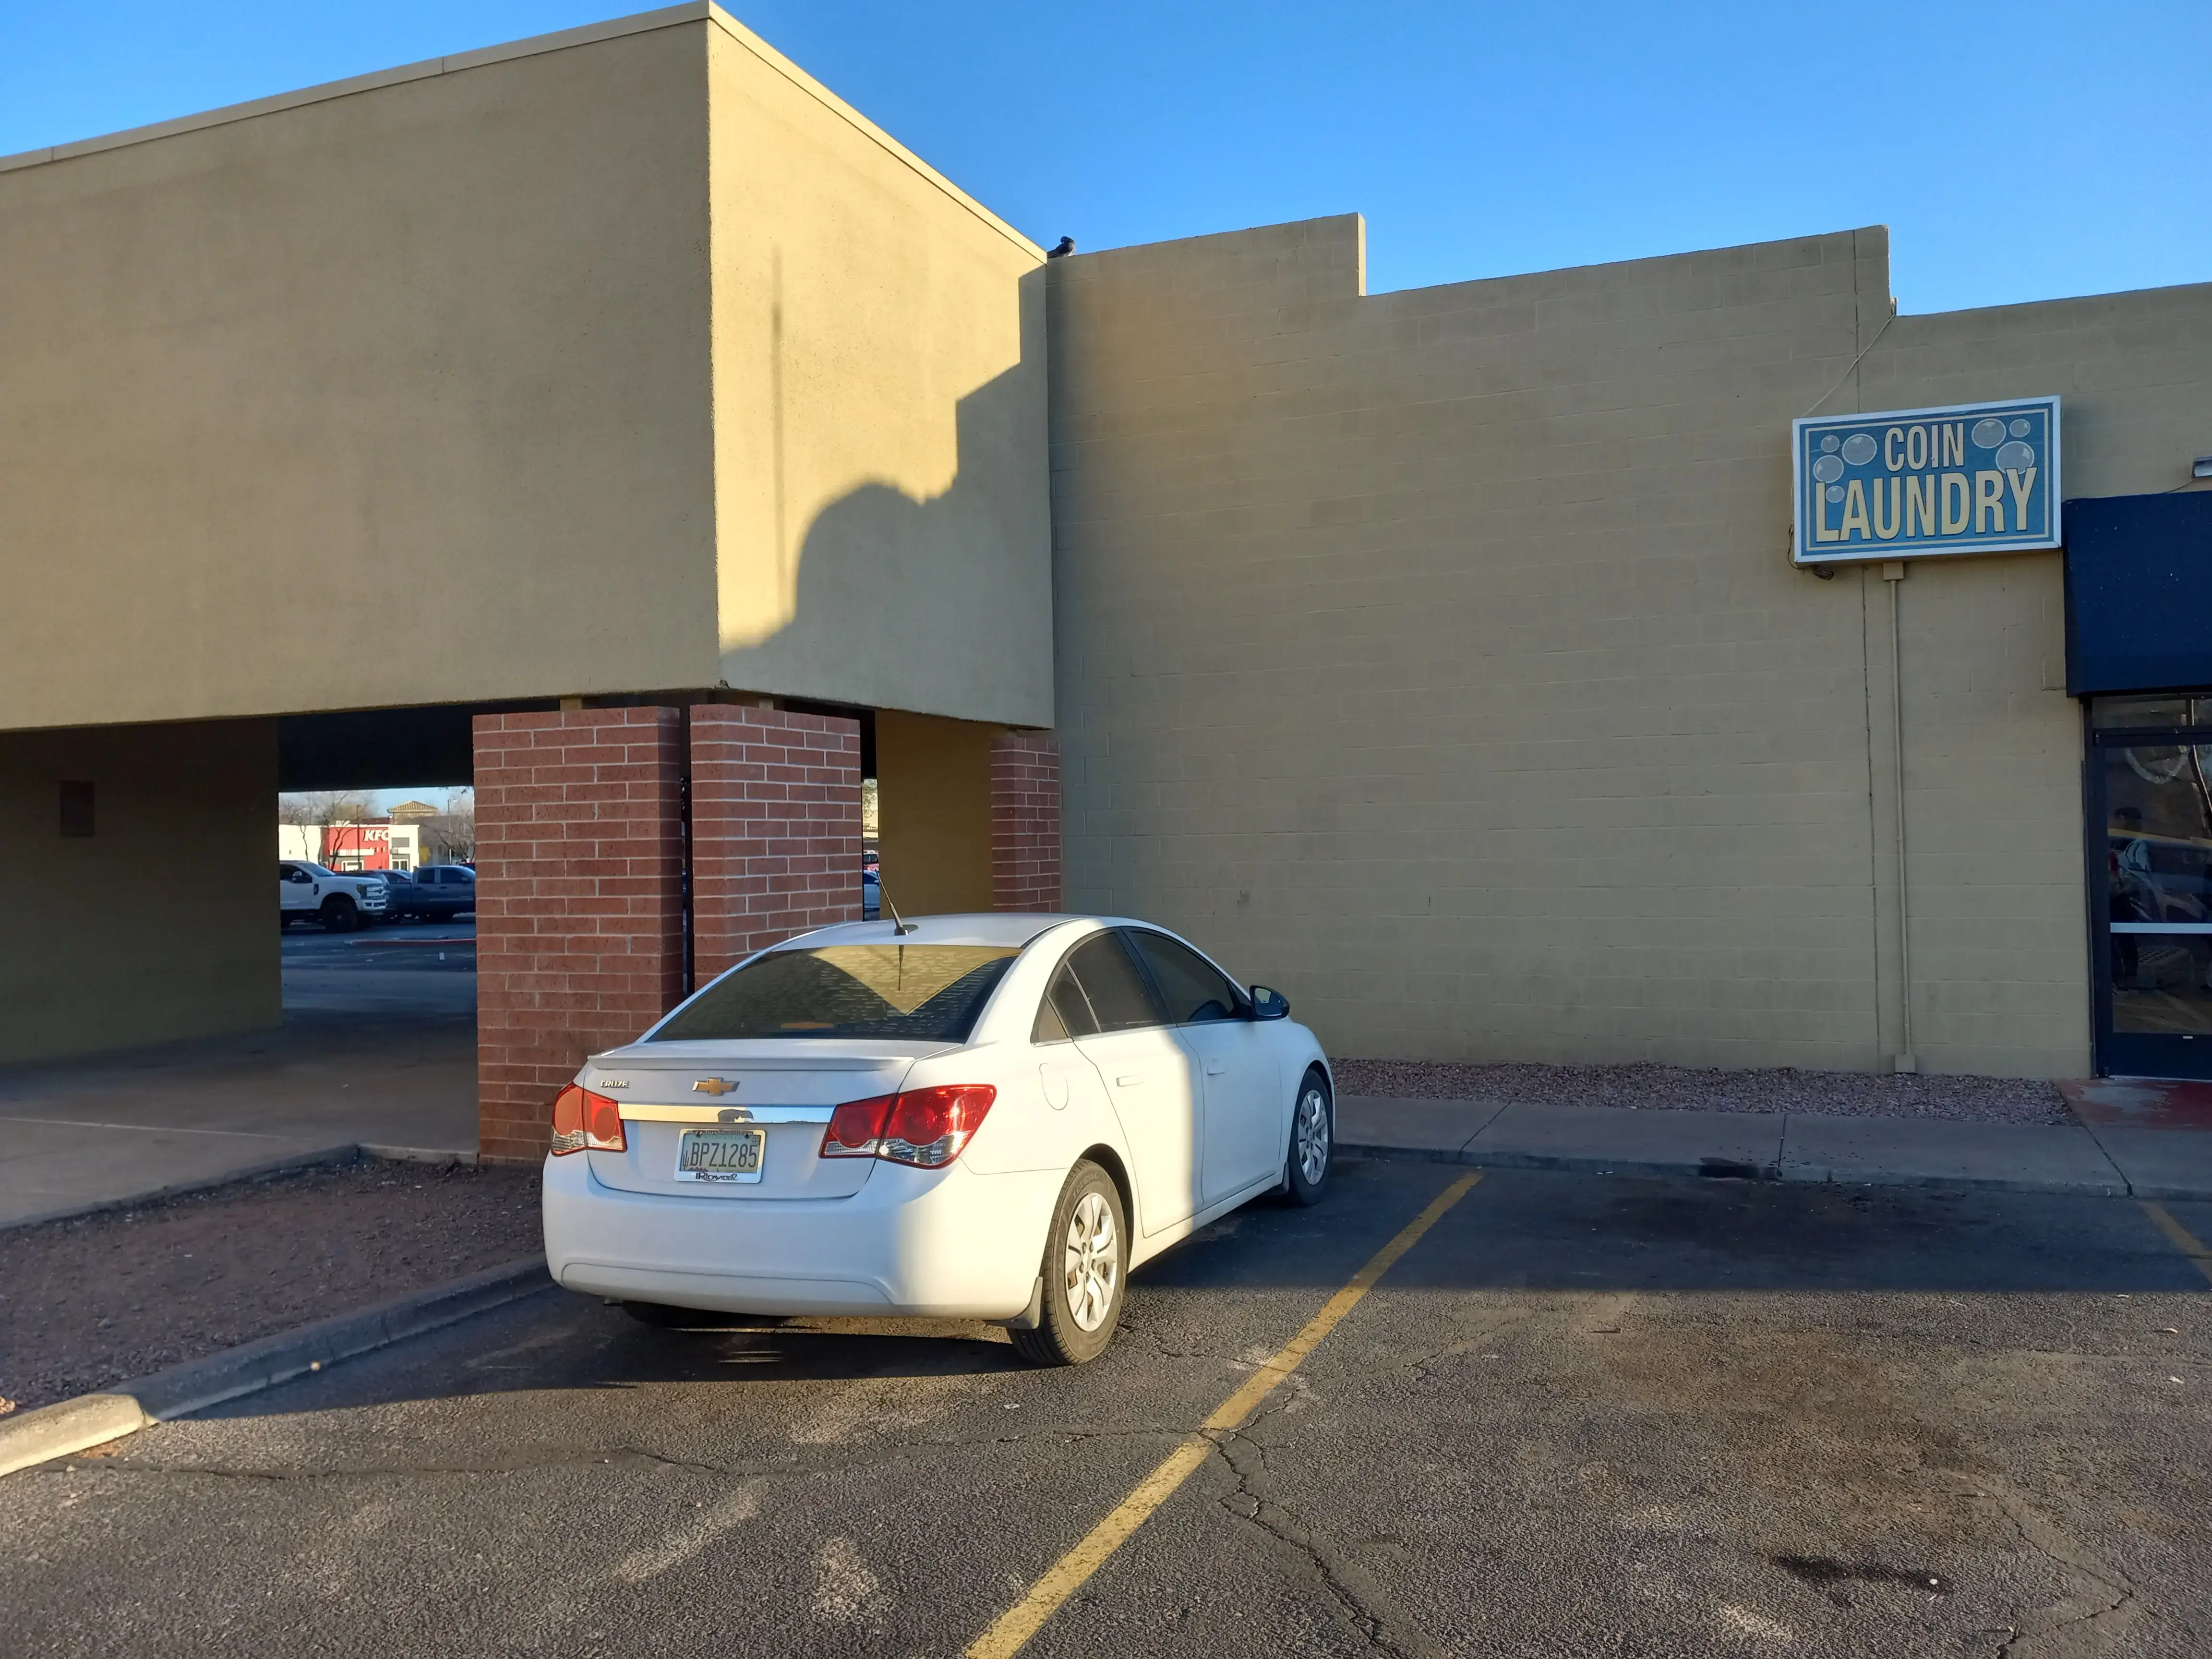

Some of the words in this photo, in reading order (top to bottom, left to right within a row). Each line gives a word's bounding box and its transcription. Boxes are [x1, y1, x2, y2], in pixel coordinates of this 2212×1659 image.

[1885, 423, 1965, 472] COIN
[1815, 467, 2038, 542] LAUNDRY
[363, 830, 388, 841] KFC
[600, 1080, 629, 1089] CRUZE
[690, 1142, 758, 1167] BPZ1285
[695, 1172, 738, 1181] Royal
